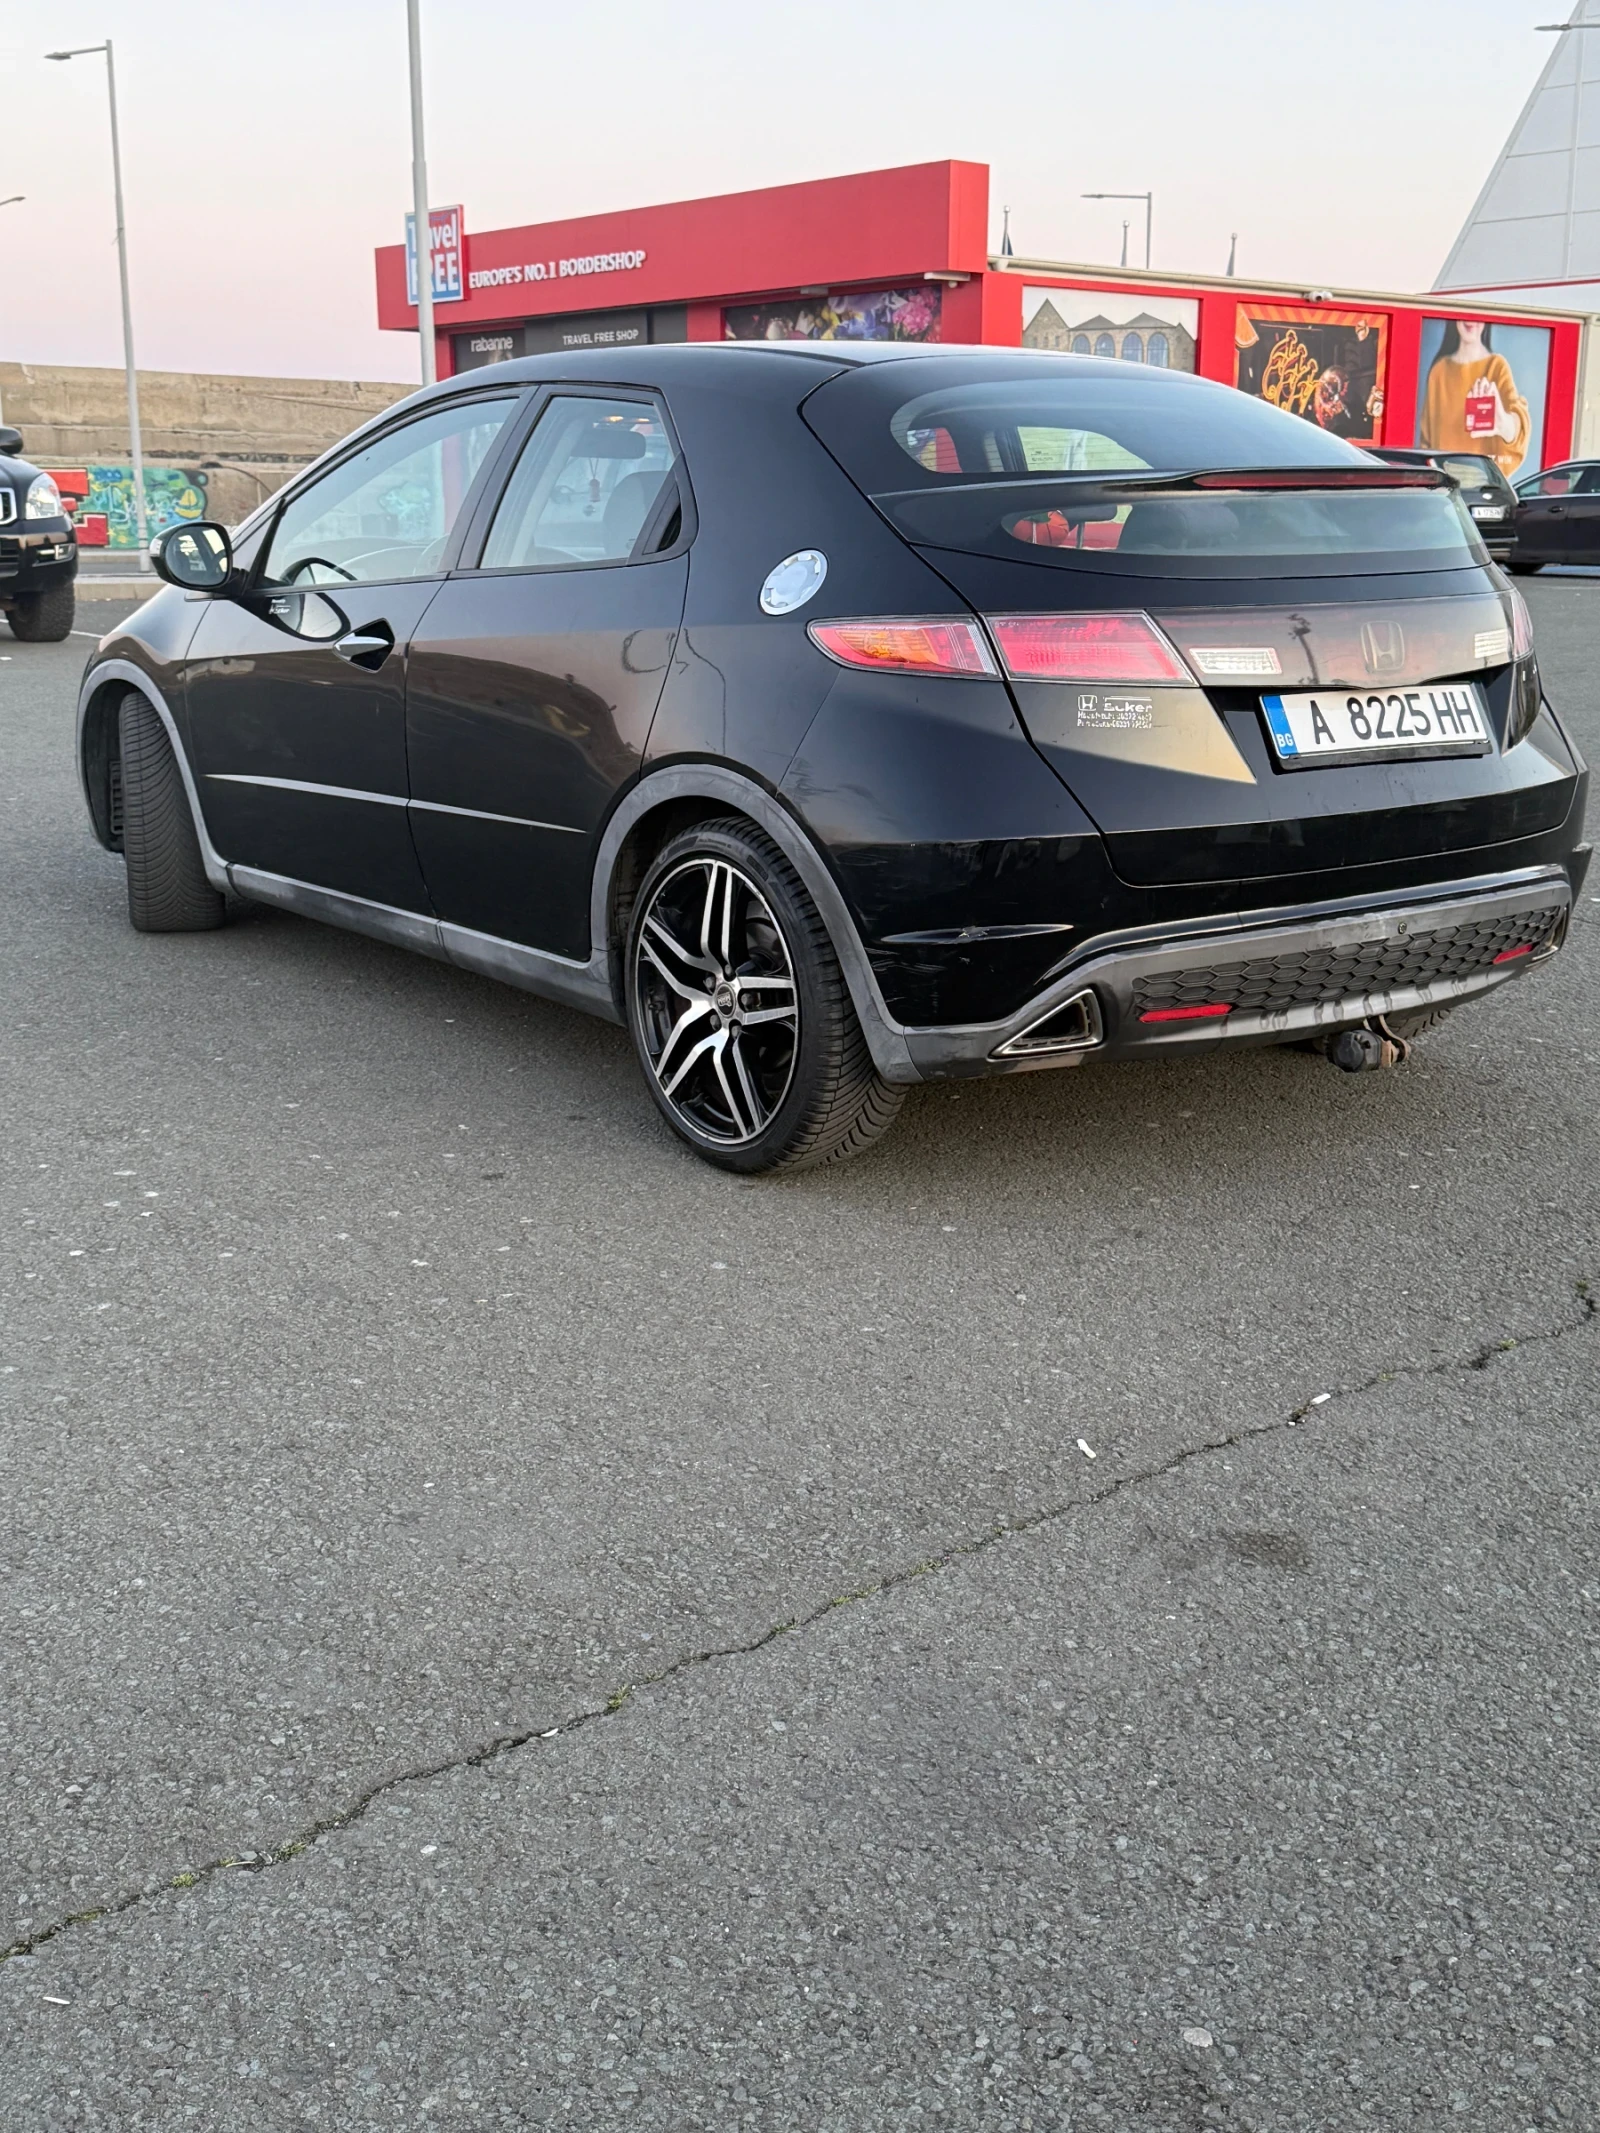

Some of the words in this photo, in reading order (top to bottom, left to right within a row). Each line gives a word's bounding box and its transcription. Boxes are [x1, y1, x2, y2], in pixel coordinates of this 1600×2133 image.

[559, 250, 646, 277] BORDERSHOP
[470, 336, 514, 353] rabanne
[562, 333, 593, 346] TRAVEL
[593, 331, 615, 343] FREE
[615, 328, 639, 342] SHOP
[1310, 700, 1336, 745] A
[1346, 693, 1431, 740] 8225
[1428, 691, 1480, 735] HH
[1277, 732, 1294, 748] BG
